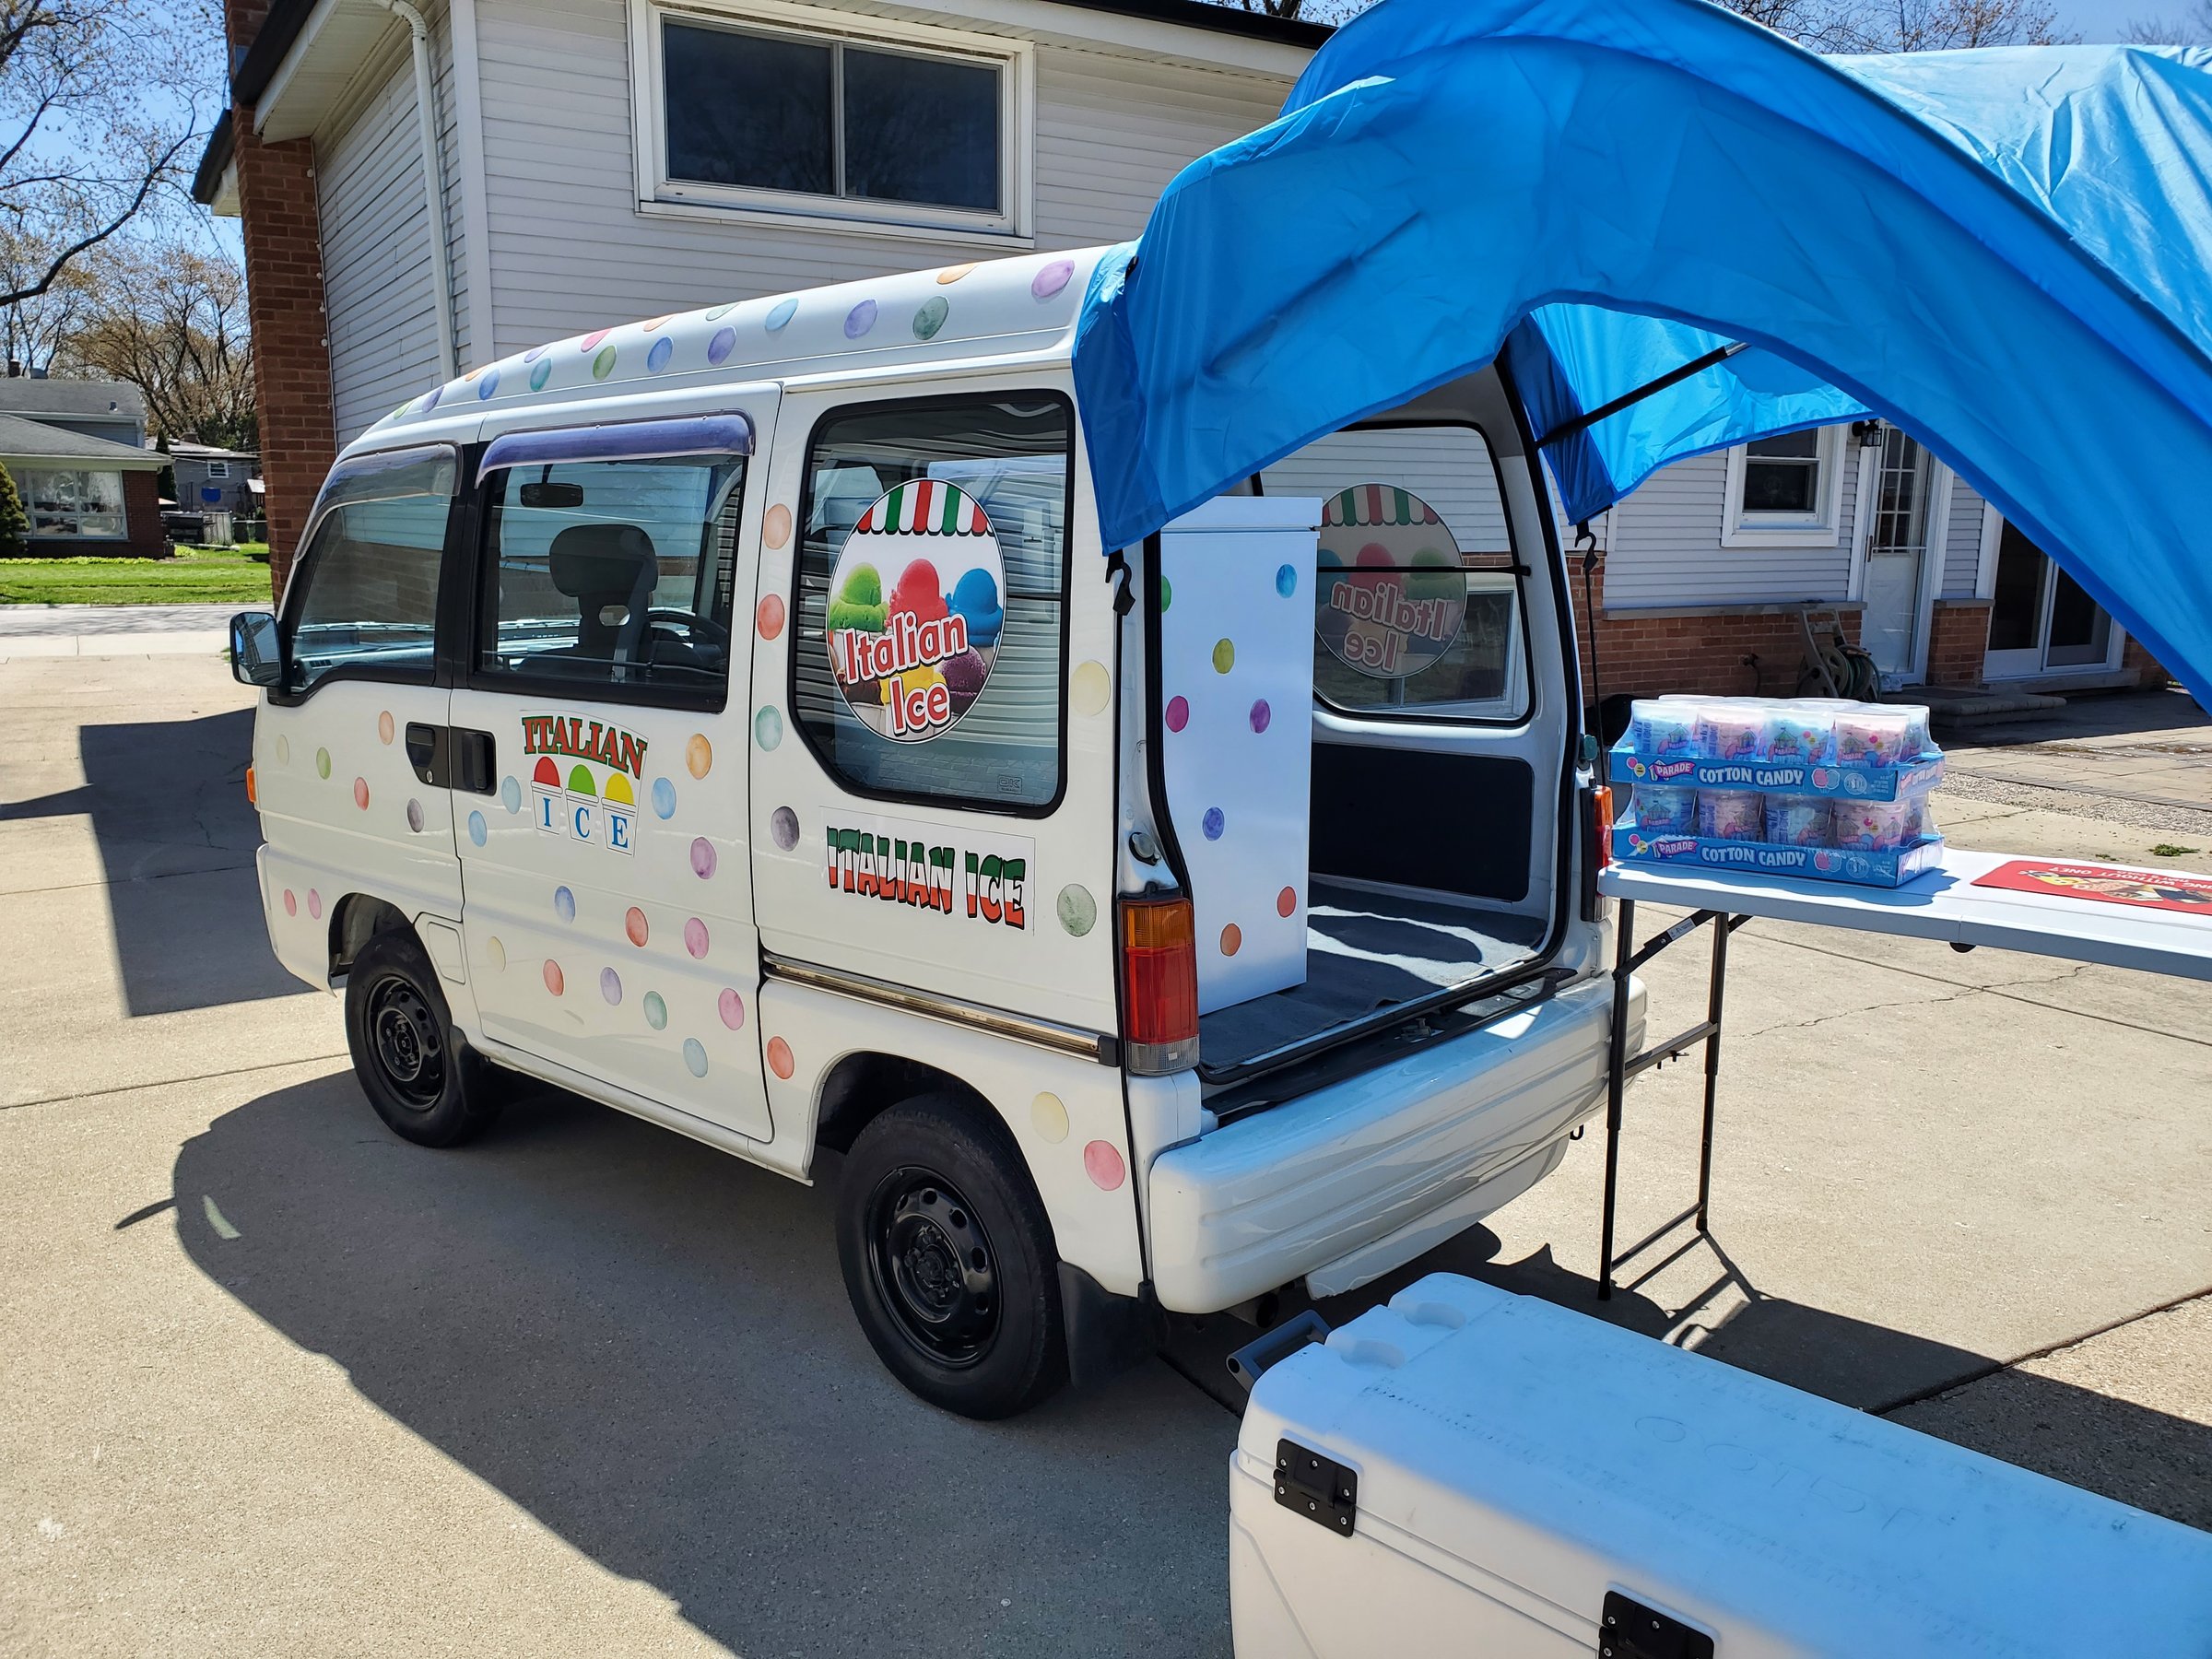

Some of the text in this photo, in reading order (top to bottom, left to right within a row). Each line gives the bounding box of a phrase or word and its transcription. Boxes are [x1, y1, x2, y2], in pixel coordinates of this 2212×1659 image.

[842, 612, 968, 685] Italian
[890, 677, 950, 735] Ice
[522, 715, 648, 781] ITALIAN
[1657, 763, 1804, 785] PARADE COTTON CANDY
[543, 797, 629, 849] ICE
[827, 826, 1026, 930] ITALIAN ICE
[1659, 841, 1806, 866] PARADE COTTON CANDY
[2049, 866, 2092, 875] ONE?
[2098, 871, 2175, 886] WITHOUT
